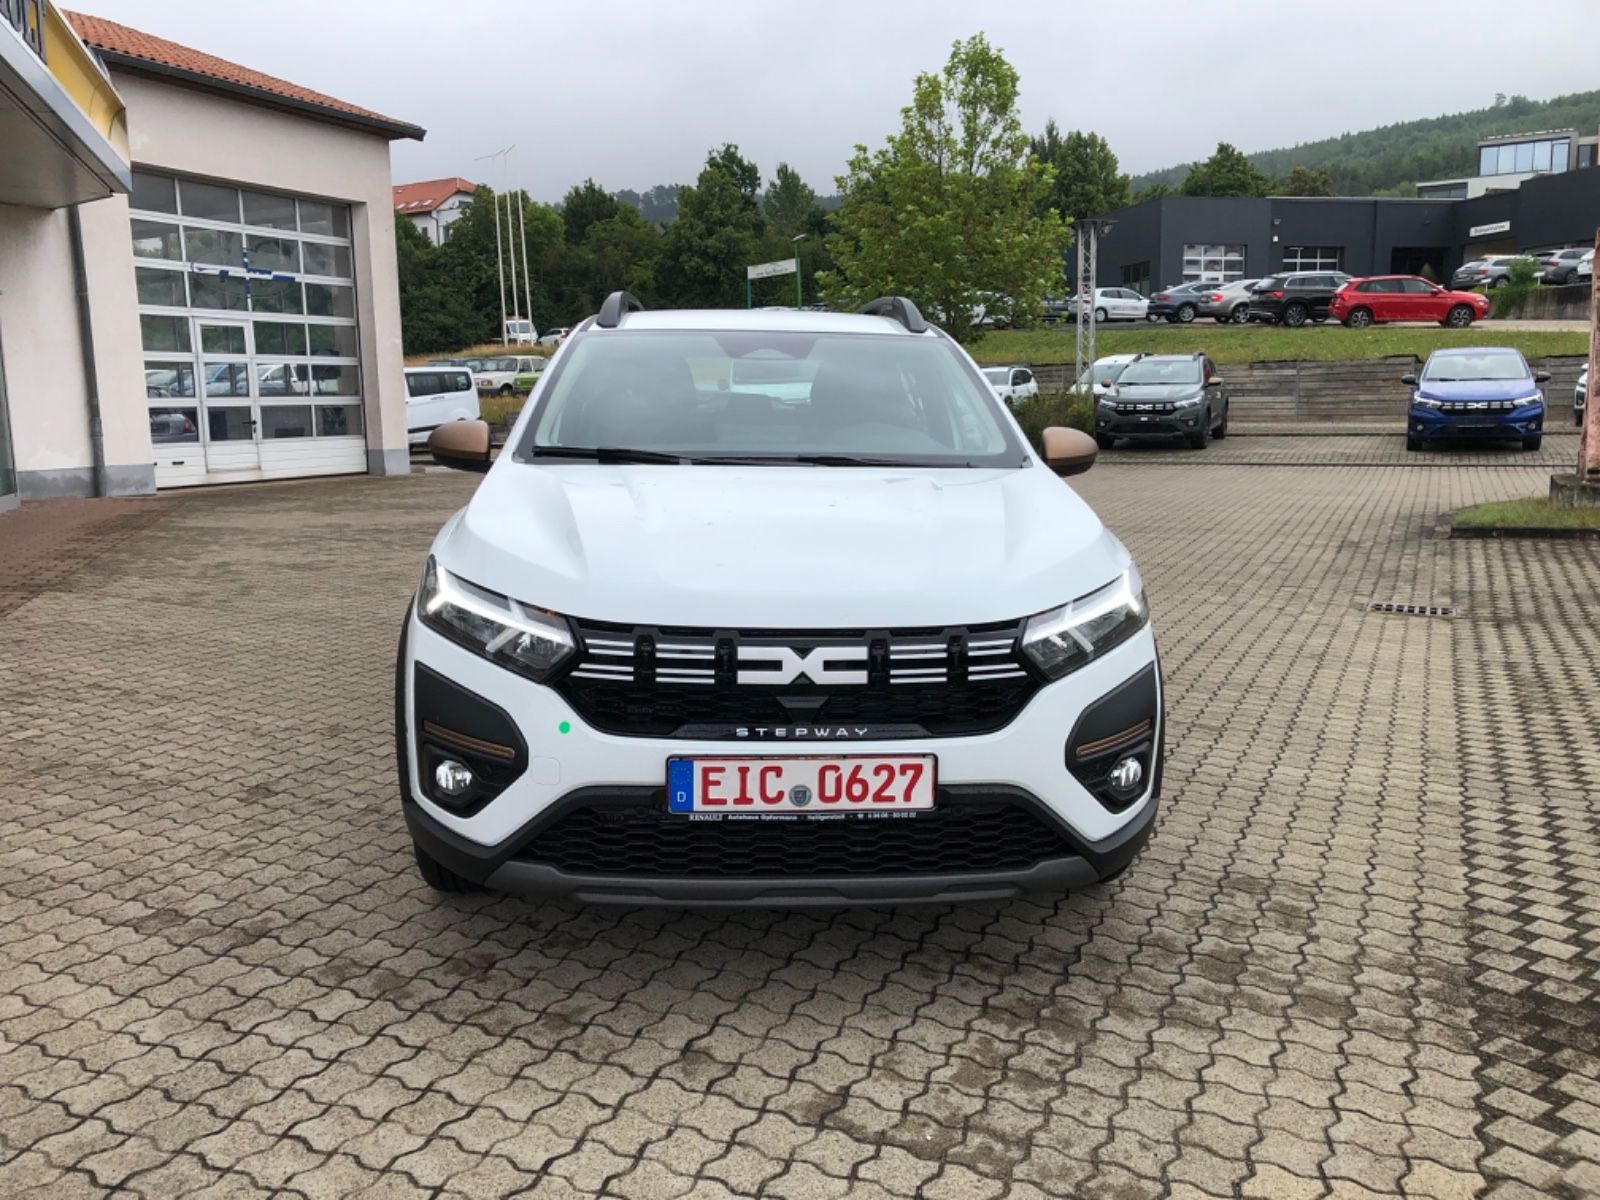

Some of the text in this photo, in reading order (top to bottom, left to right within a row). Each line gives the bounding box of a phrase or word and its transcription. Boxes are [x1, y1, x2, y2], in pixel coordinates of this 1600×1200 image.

[735, 727, 868, 738] STEPWAY
[701, 765, 785, 806] EIC
[817, 763, 924, 805] 0627
[676, 791, 687, 803] D
